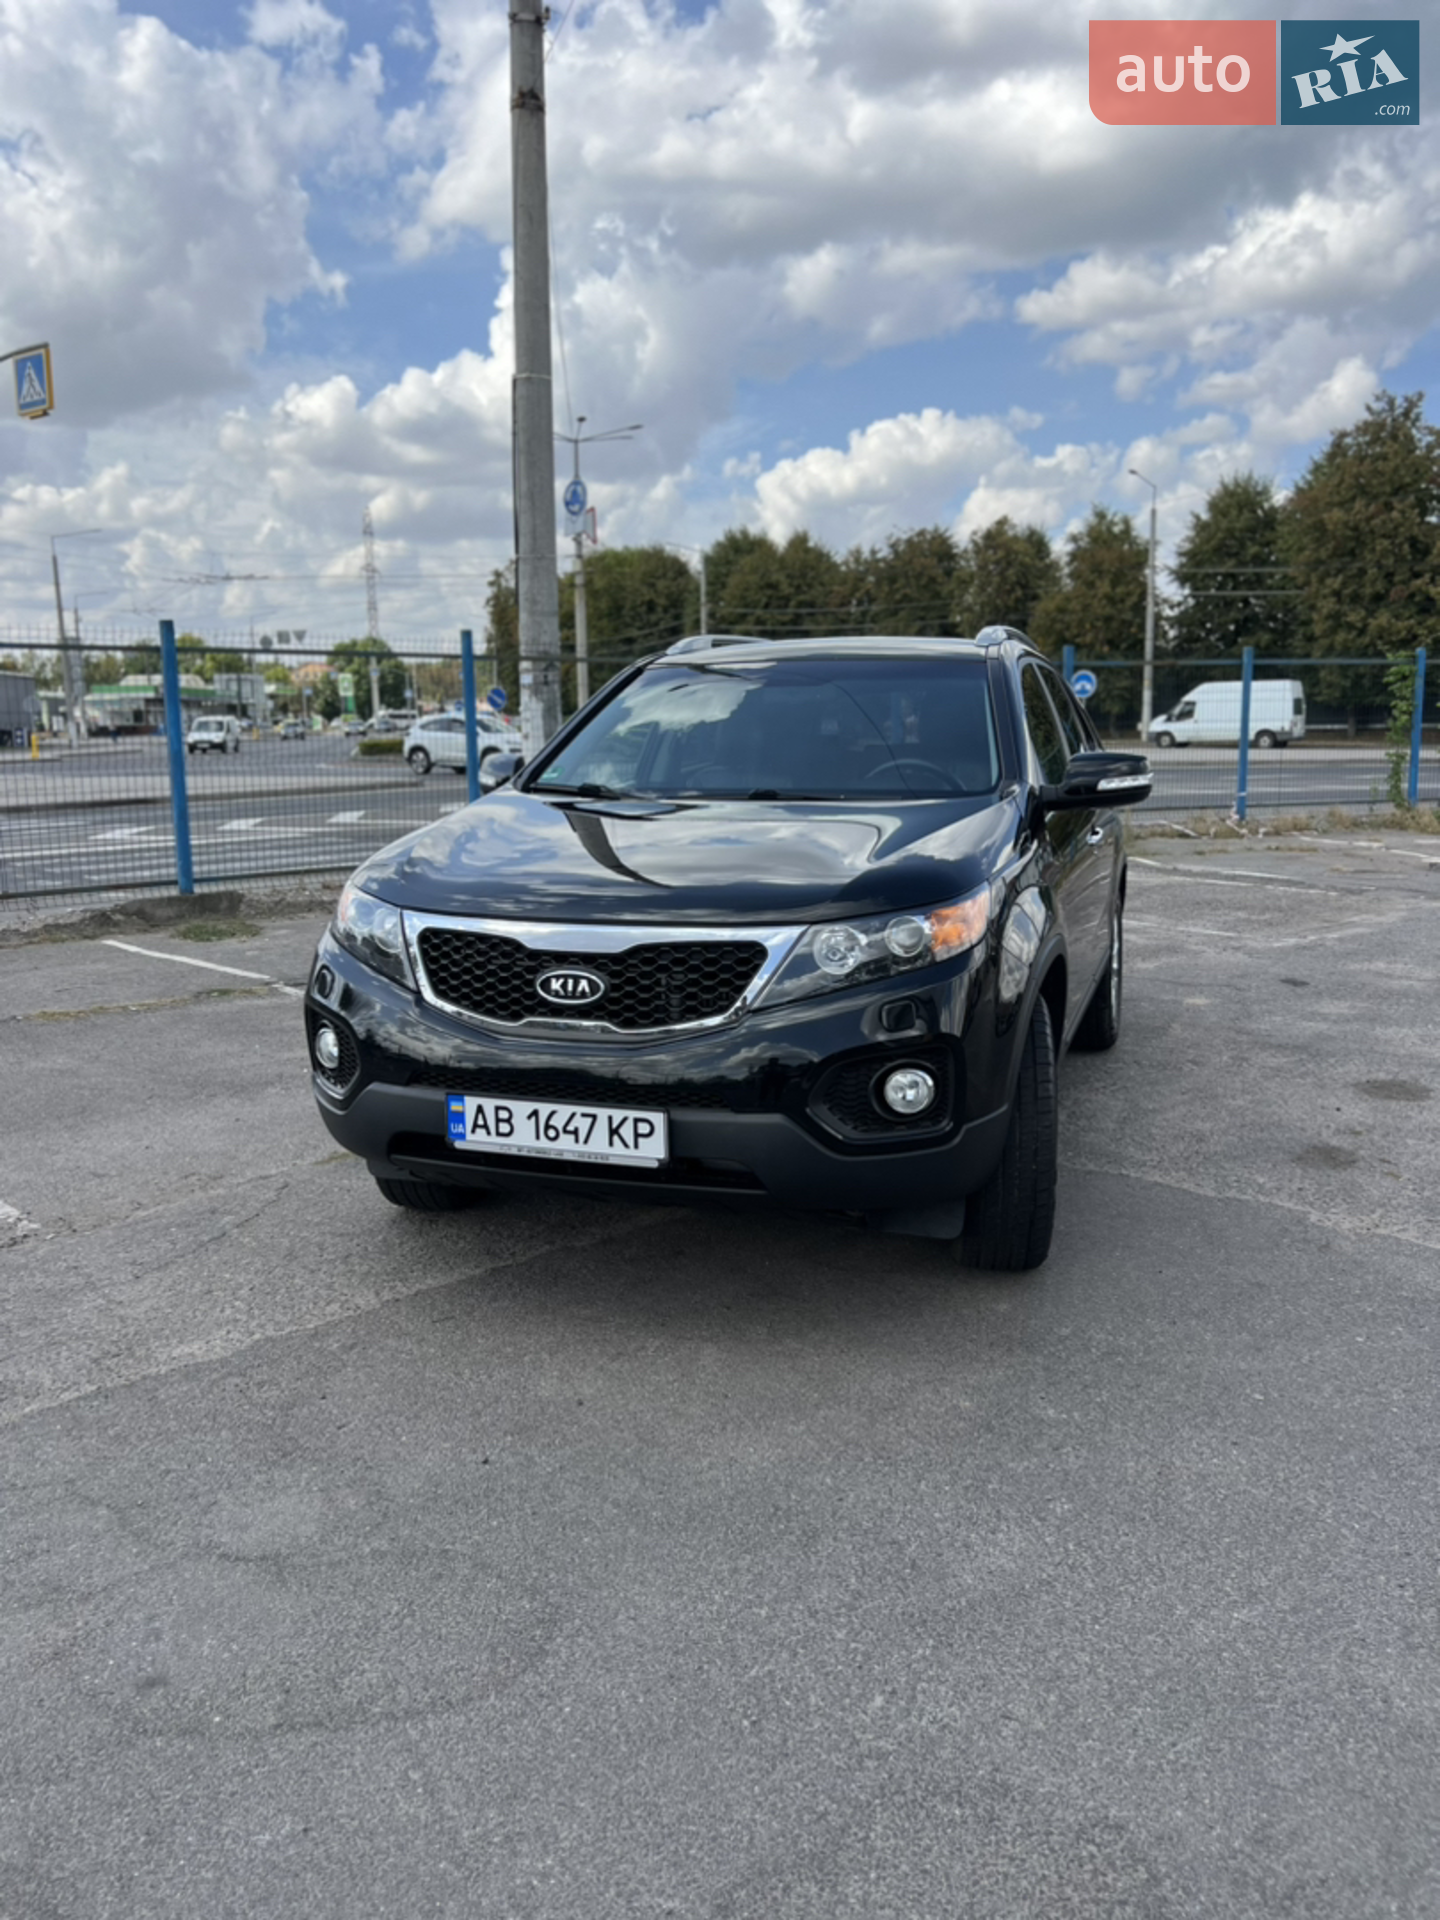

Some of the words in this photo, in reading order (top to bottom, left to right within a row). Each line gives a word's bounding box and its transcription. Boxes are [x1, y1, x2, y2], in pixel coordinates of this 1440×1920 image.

[550, 977, 591, 997] KIA
[451, 1122, 465, 1134] UA
[470, 1103, 514, 1138] AB
[526, 1108, 598, 1145] 1647
[607, 1114, 656, 1150] KP
